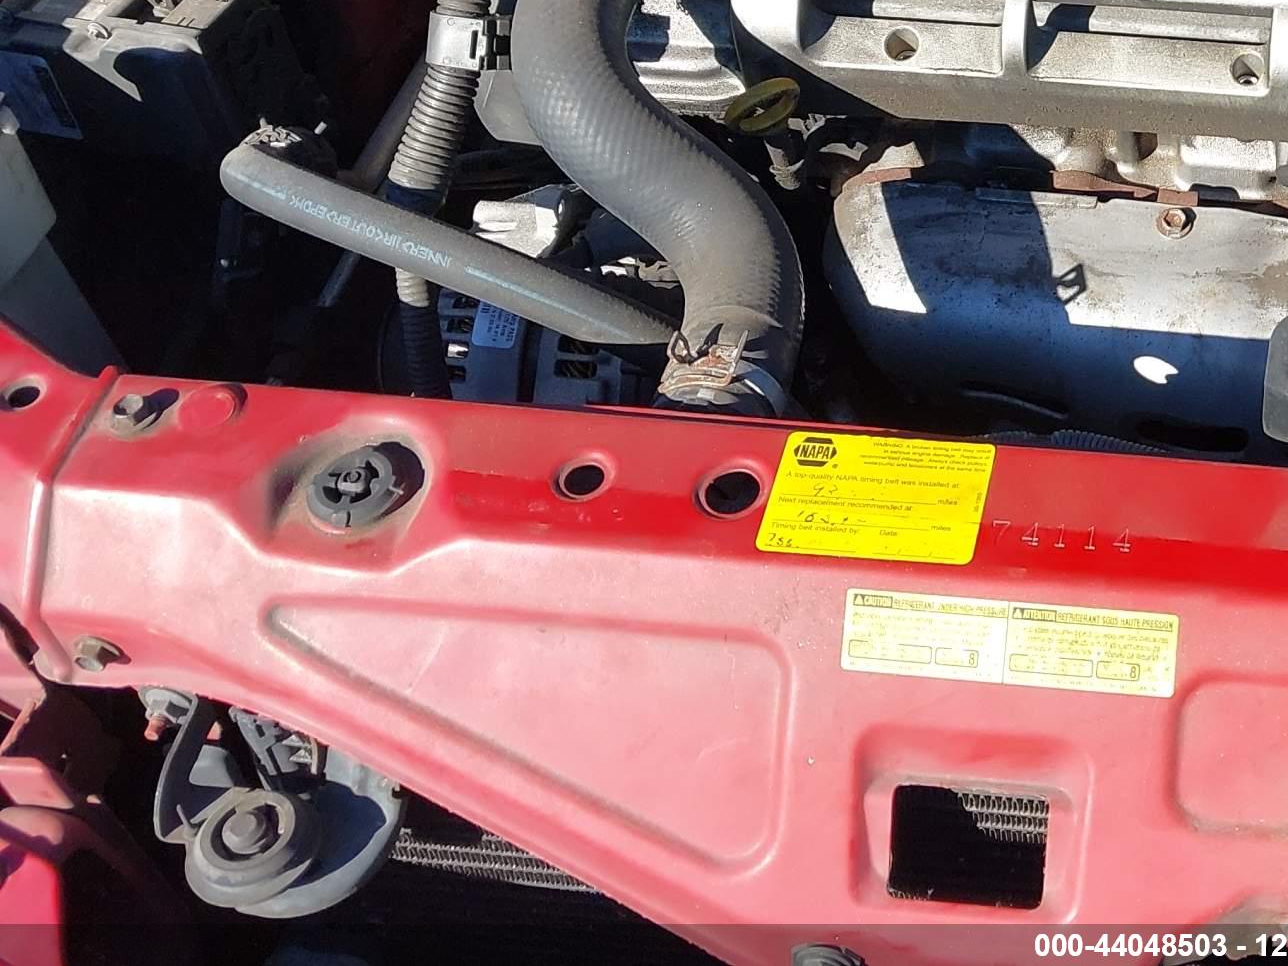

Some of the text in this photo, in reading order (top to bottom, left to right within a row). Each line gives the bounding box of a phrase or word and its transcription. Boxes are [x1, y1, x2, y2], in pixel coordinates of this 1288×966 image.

[800, 444, 831, 460] NAPA
[835, 474, 859, 482] NAPA
[864, 596, 892, 608] CAUTION
